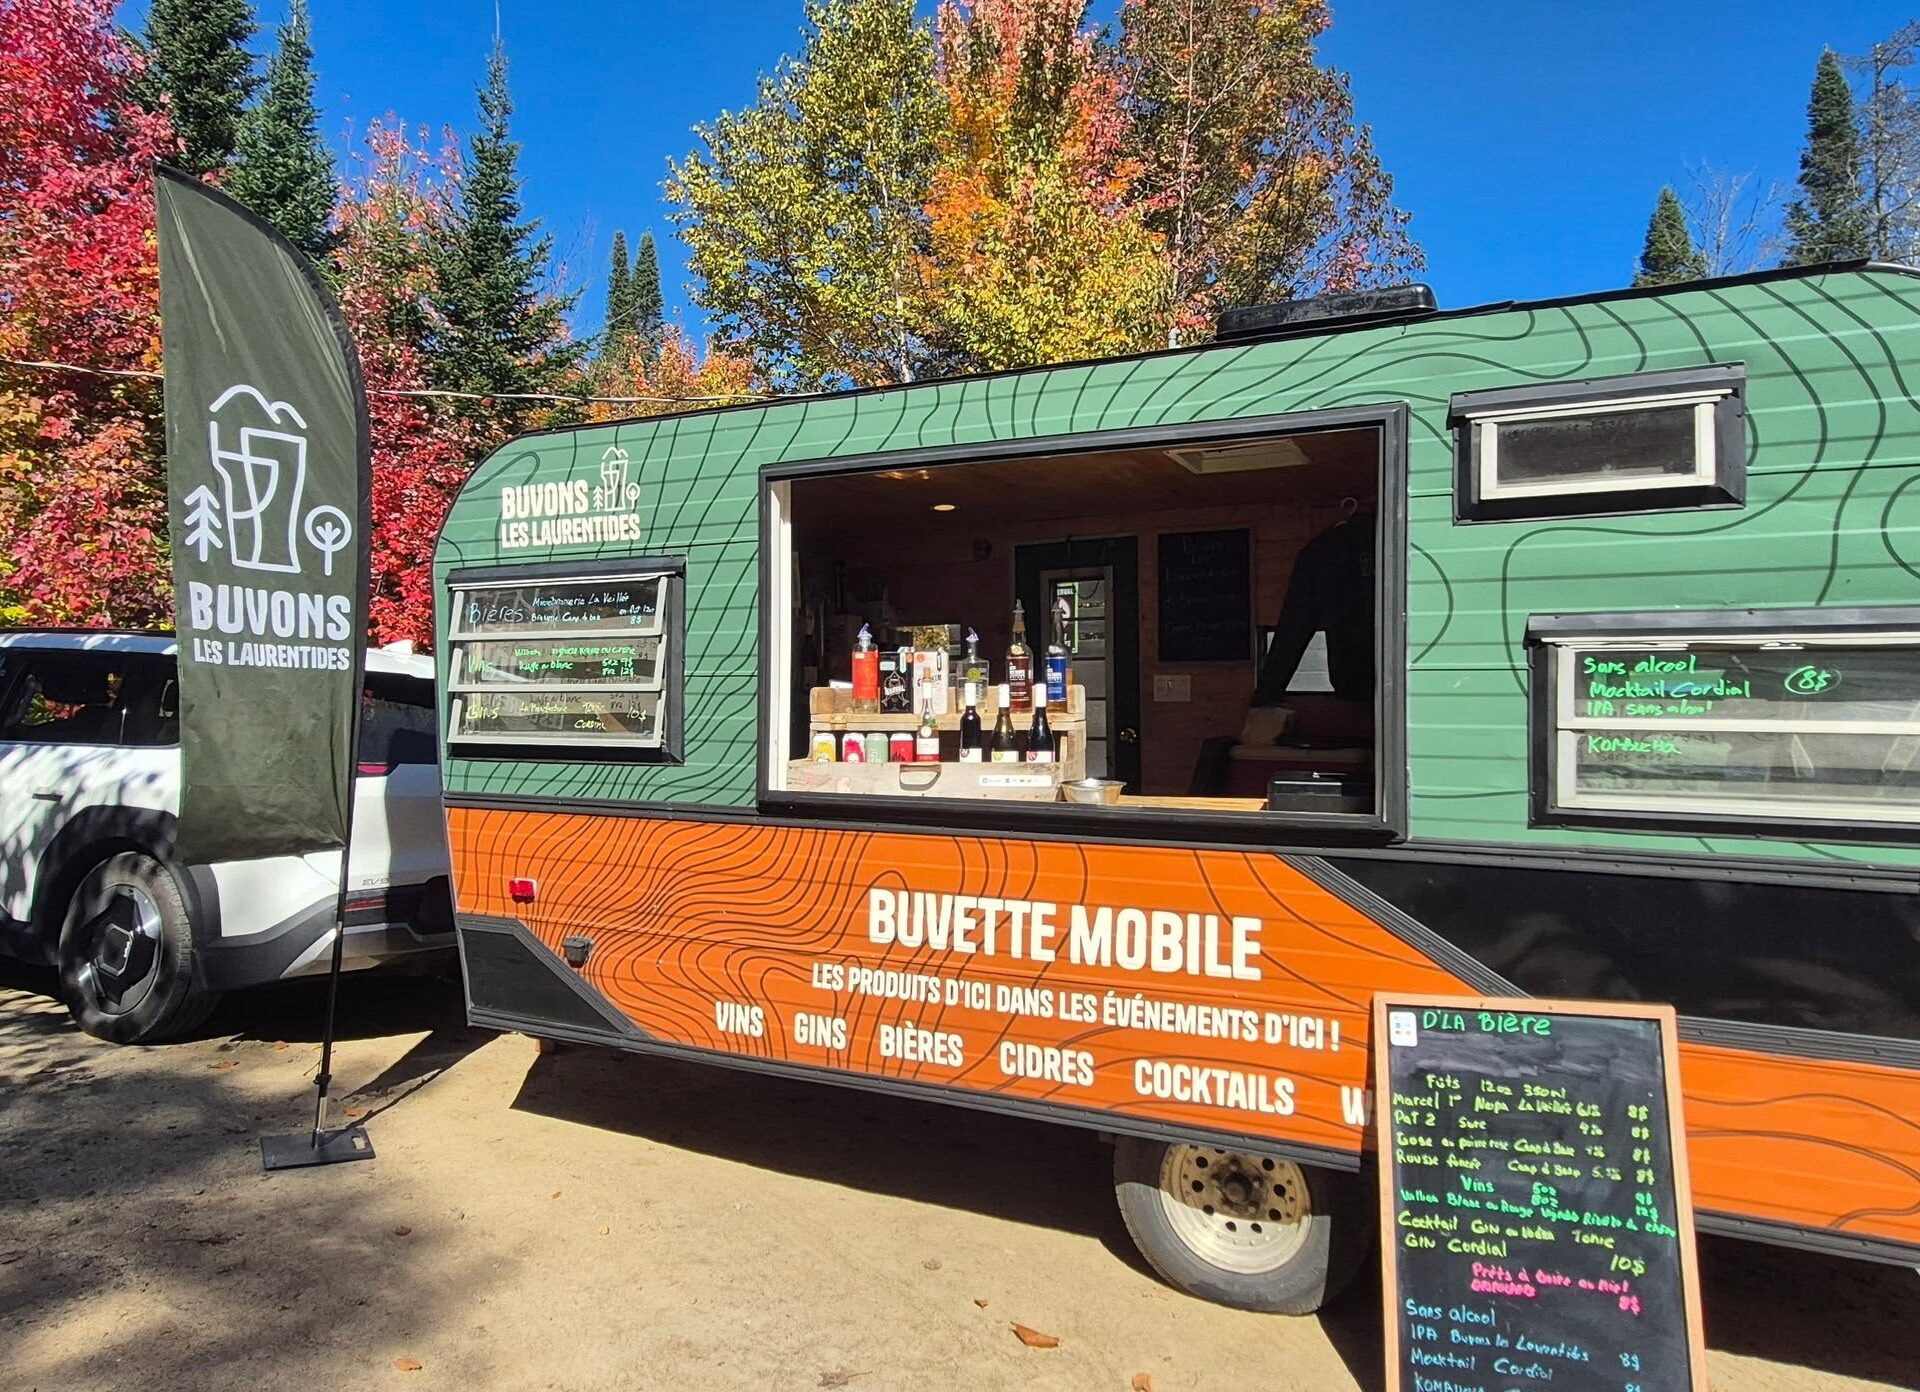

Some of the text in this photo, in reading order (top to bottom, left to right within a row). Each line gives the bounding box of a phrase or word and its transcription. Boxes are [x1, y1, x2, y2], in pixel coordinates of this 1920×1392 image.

[502, 479, 588, 520] BUVONS
[502, 513, 641, 548] LES LAURENTIDES
[189, 581, 350, 640] BUVONS
[469, 602, 523, 624] Bières
[194, 638, 350, 671] LES LAURENTIDES
[1584, 654, 1697, 675] Sans alcool
[1590, 680, 1750, 698] Mocktail Cordial
[1797, 669, 1832, 691] 8$
[869, 887, 1262, 980] BUVETTE MOBILE
[811, 962, 844, 991] LES
[848, 967, 941, 1004] PRODUITS
[996, 986, 1053, 1018] DANS
[1059, 991, 1098, 1024] LES
[1103, 990, 1259, 1042] ÉVÉNEMENTS
[1264, 1012, 1324, 1050] D'ICI
[715, 1001, 764, 1038] VINS
[794, 1013, 847, 1050] GINS
[879, 1020, 964, 1067] BIÈRES
[999, 1040, 1094, 1087] CIDRES
[1134, 1058, 1295, 1116] COCKTAILS
[1393, 1091, 1439, 1110] Marcel
[1460, 1174, 1495, 1193] Vins
[1397, 1210, 1458, 1231] Cocktail
[1610, 1254, 1645, 1277] 10$
[1406, 1298, 1496, 1327] Sans alcool
[1411, 1323, 1438, 1341] IPA
[1493, 1357, 1553, 1381] Cordial
